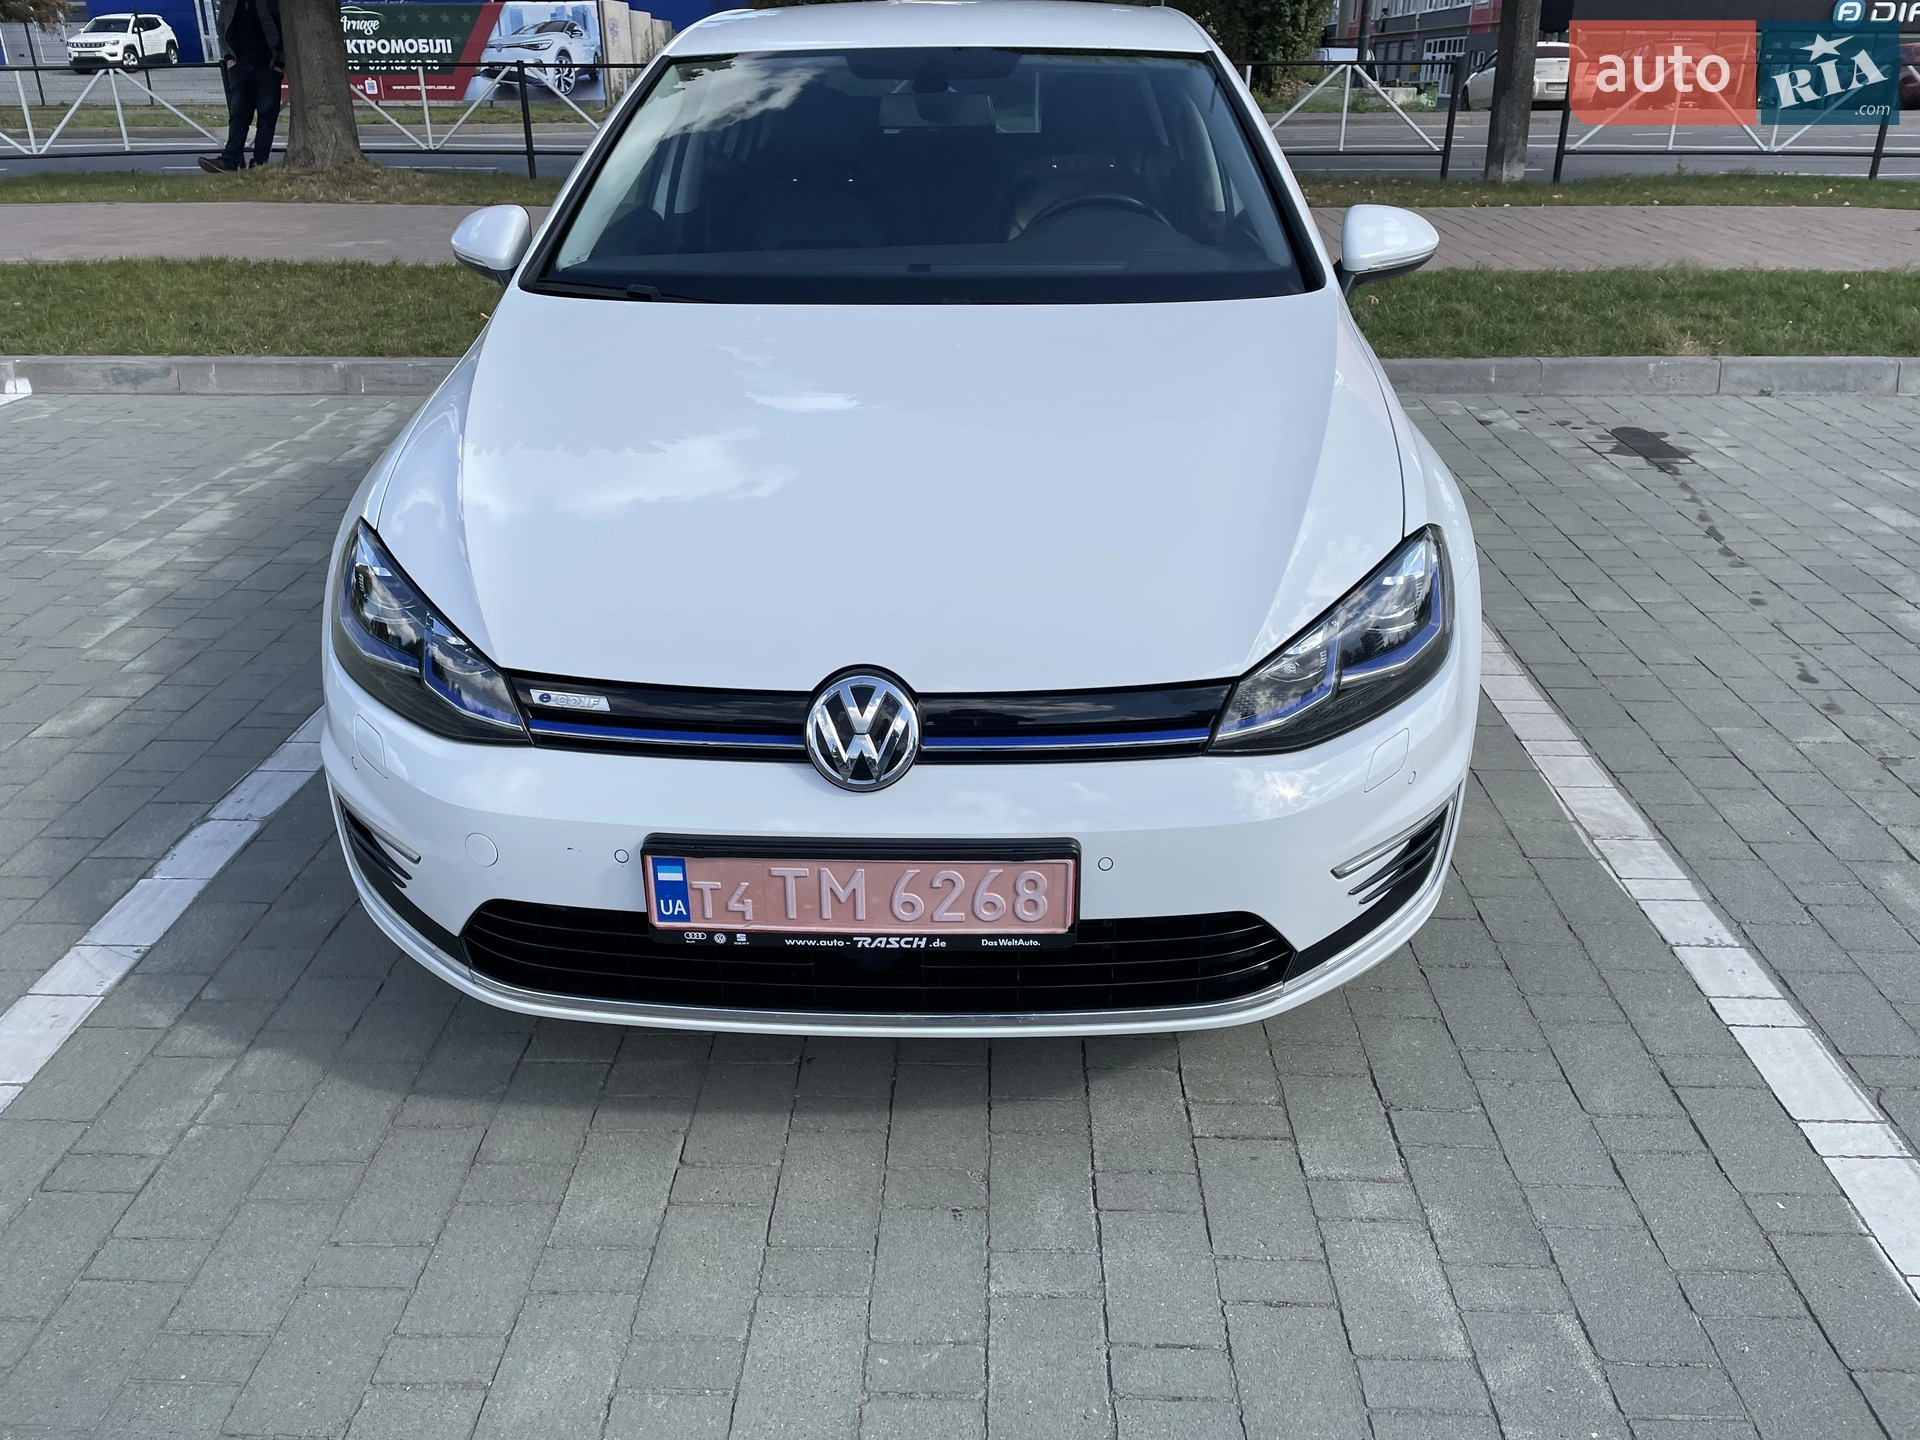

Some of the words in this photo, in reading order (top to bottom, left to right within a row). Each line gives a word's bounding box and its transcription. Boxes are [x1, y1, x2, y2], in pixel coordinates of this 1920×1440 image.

[343, 38, 453, 54] КТРОМОБІЛІ
[769, 867, 865, 921] TM
[891, 869, 1048, 923] 6268
[660, 899, 687, 916] UA
